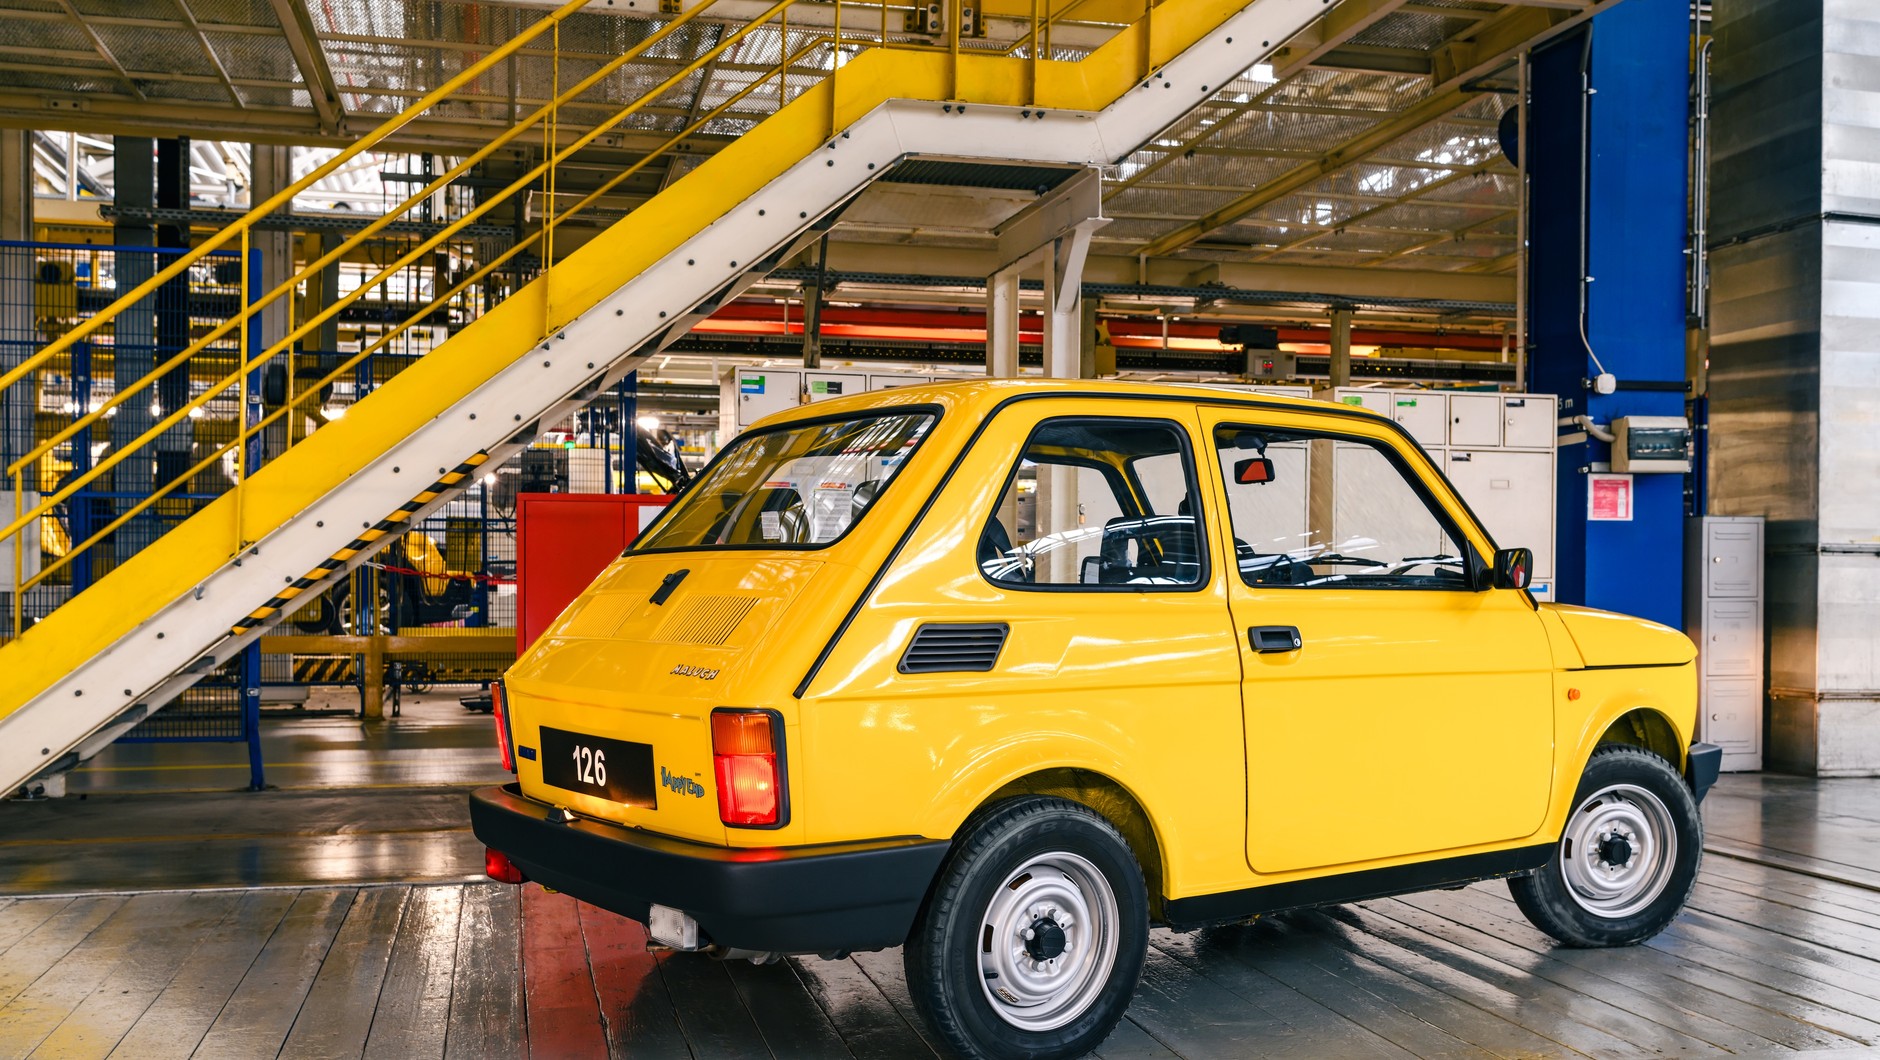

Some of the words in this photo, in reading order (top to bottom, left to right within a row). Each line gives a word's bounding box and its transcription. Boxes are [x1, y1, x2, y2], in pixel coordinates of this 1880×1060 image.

[1565, 398, 1573, 408] m
[670, 664, 720, 680] MALUCH
[573, 745, 606, 787] 126
